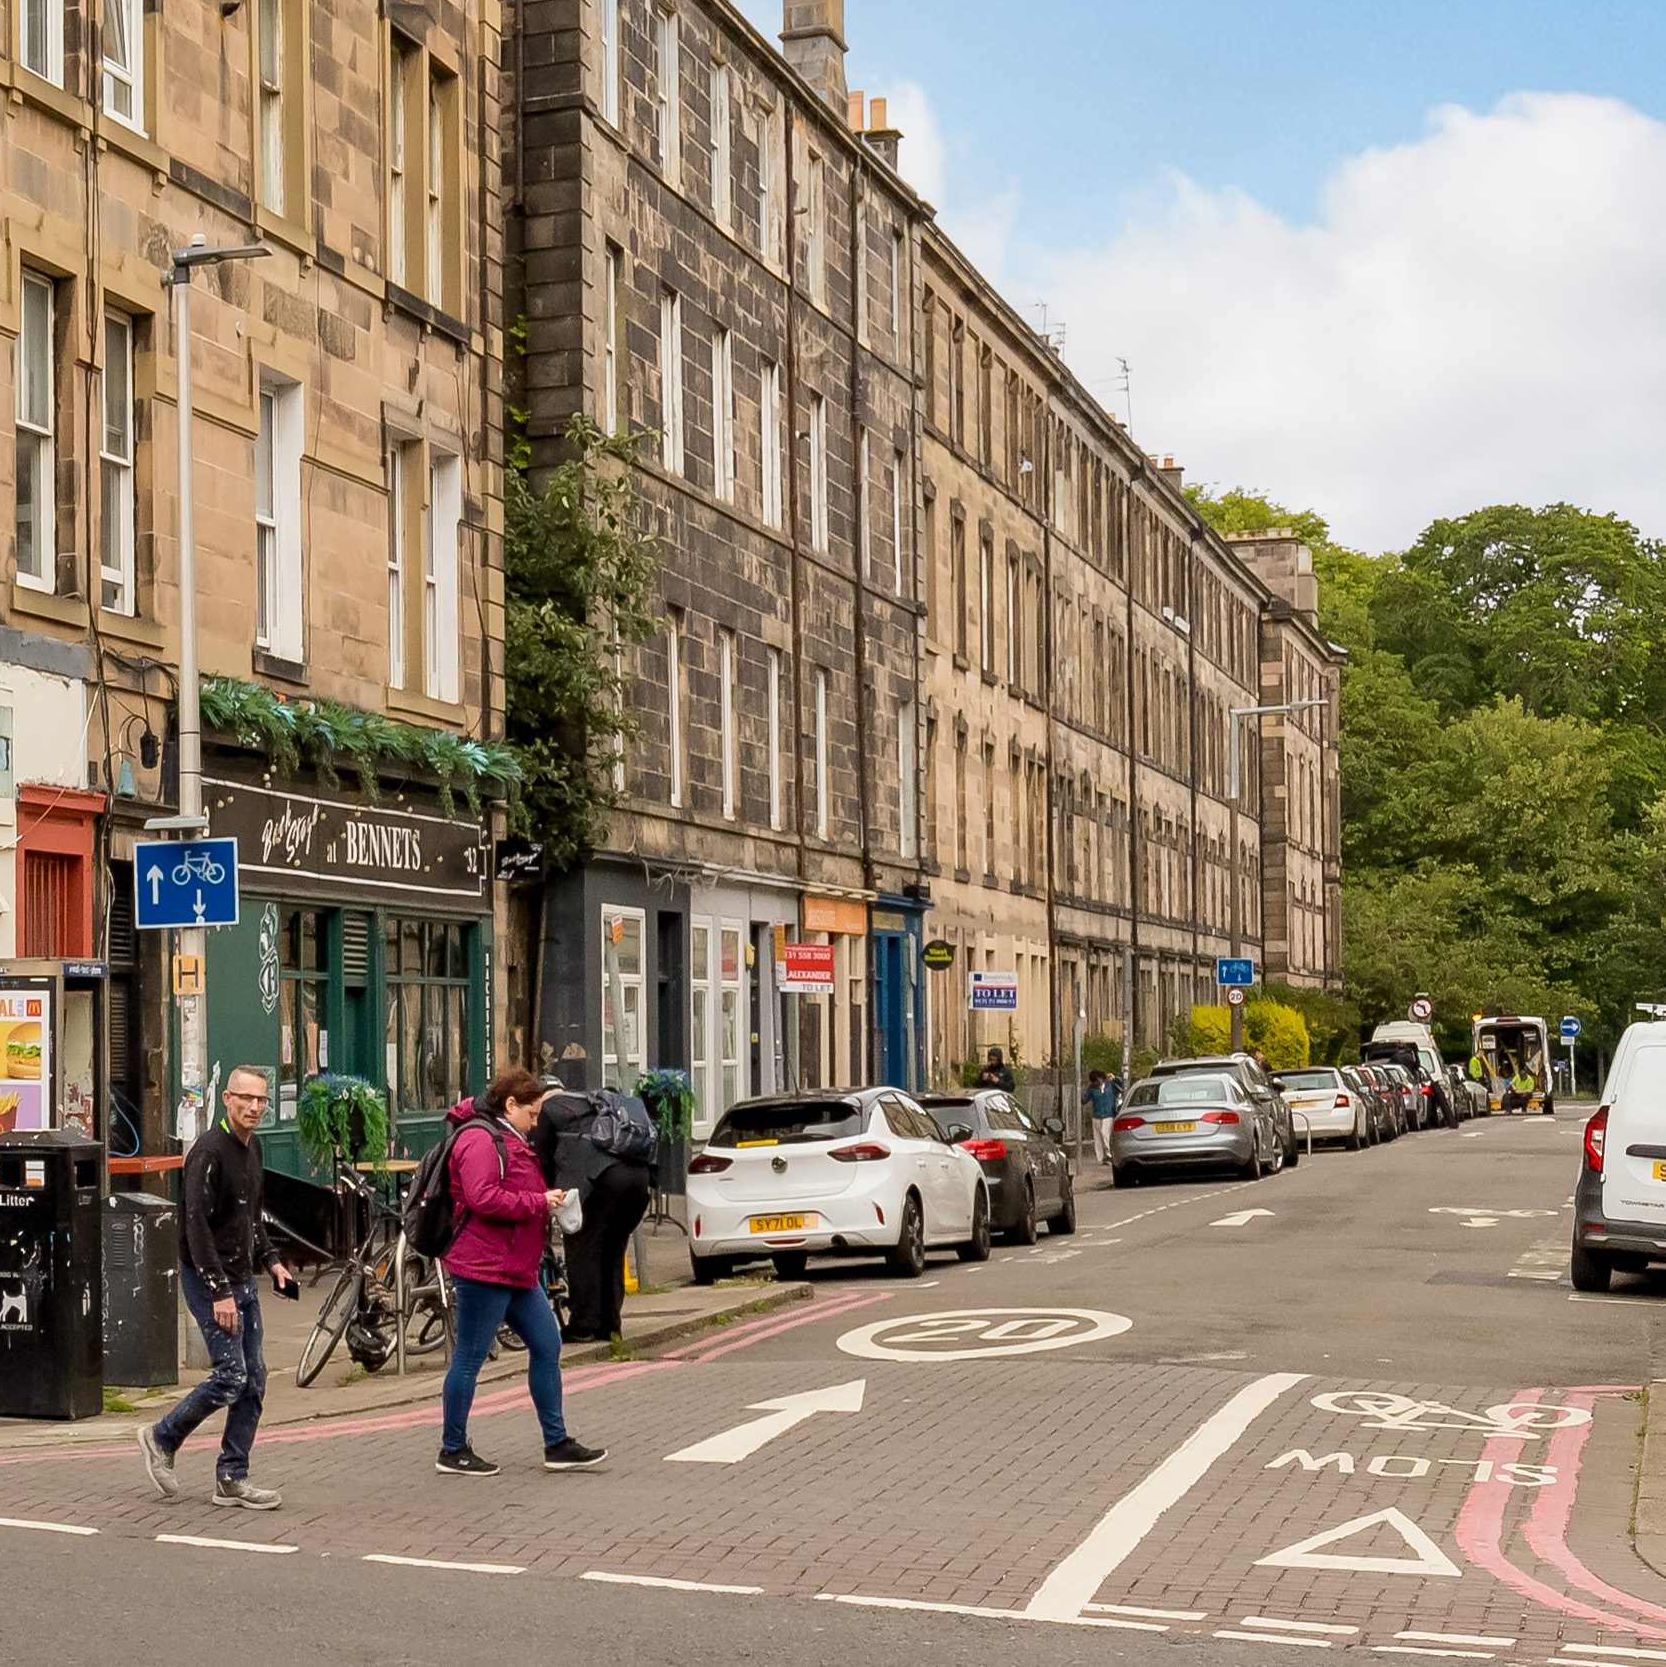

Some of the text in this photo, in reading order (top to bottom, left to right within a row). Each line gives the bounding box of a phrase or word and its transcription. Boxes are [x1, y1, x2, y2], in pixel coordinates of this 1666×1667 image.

[346, 820, 421, 871] BENNETS
[178, 958, 199, 989] H
[787, 970, 832, 980] ALEXANDER
[802, 983, 831, 992] TO LET
[975, 989, 1016, 999] TO LET
[1230, 993, 1242, 1001] 20
[1619, 1199, 1666, 1209] TOWNSTAR
[756, 1217, 784, 1232] SY71
[0, 1323, 34, 1331] ACCEPTED
[882, 1317, 1080, 1343] 20
[1264, 1448, 1559, 1487] SLOW
